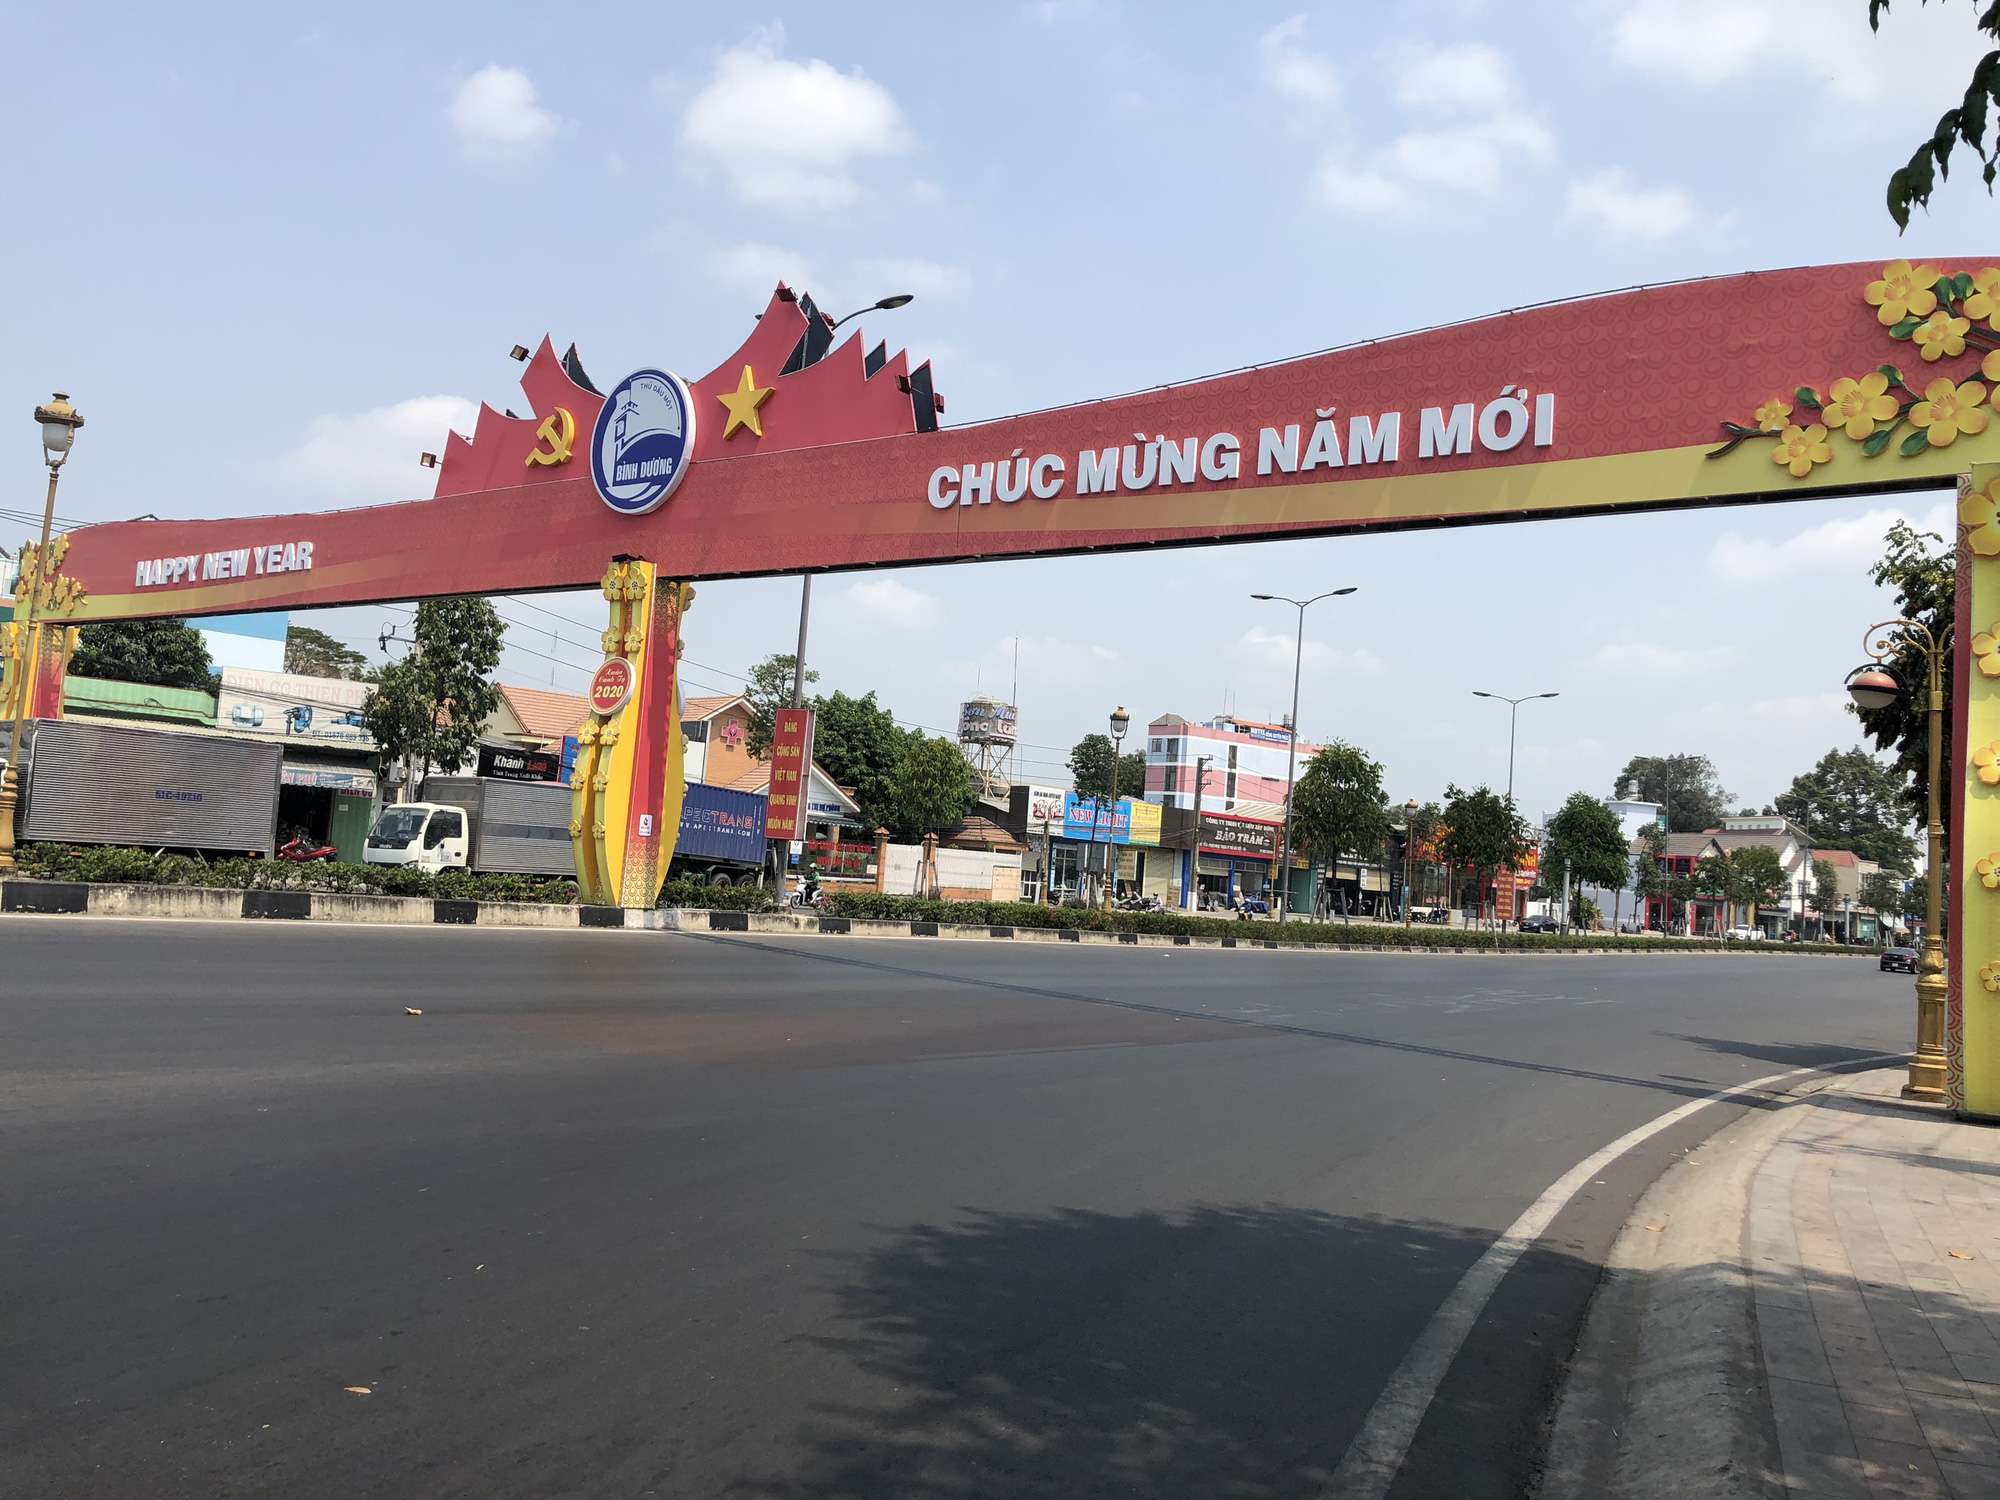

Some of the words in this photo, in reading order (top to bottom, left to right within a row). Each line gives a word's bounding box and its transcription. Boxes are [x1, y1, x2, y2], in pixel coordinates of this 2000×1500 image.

[927, 448, 1066, 509] CHÚC
[1076, 433, 1241, 495] MỪNG
[1257, 406, 1401, 475] NĂM
[1418, 385, 1555, 459] MỚI
[616, 461, 637, 482] BÌNH
[640, 456, 672, 478] DƯƠNG
[135, 555, 201, 587] HAPPY
[202, 548, 251, 581] NEW
[253, 541, 314, 575] YEAR
[594, 685, 624, 698] 2020
[493, 755, 524, 769] Khánh
[680, 806, 753, 829] PECTRANS
[1069, 808, 1094, 824] NEW
[1215, 827, 1236, 841] BẢO
[1236, 831, 1265, 846] TRÂM
